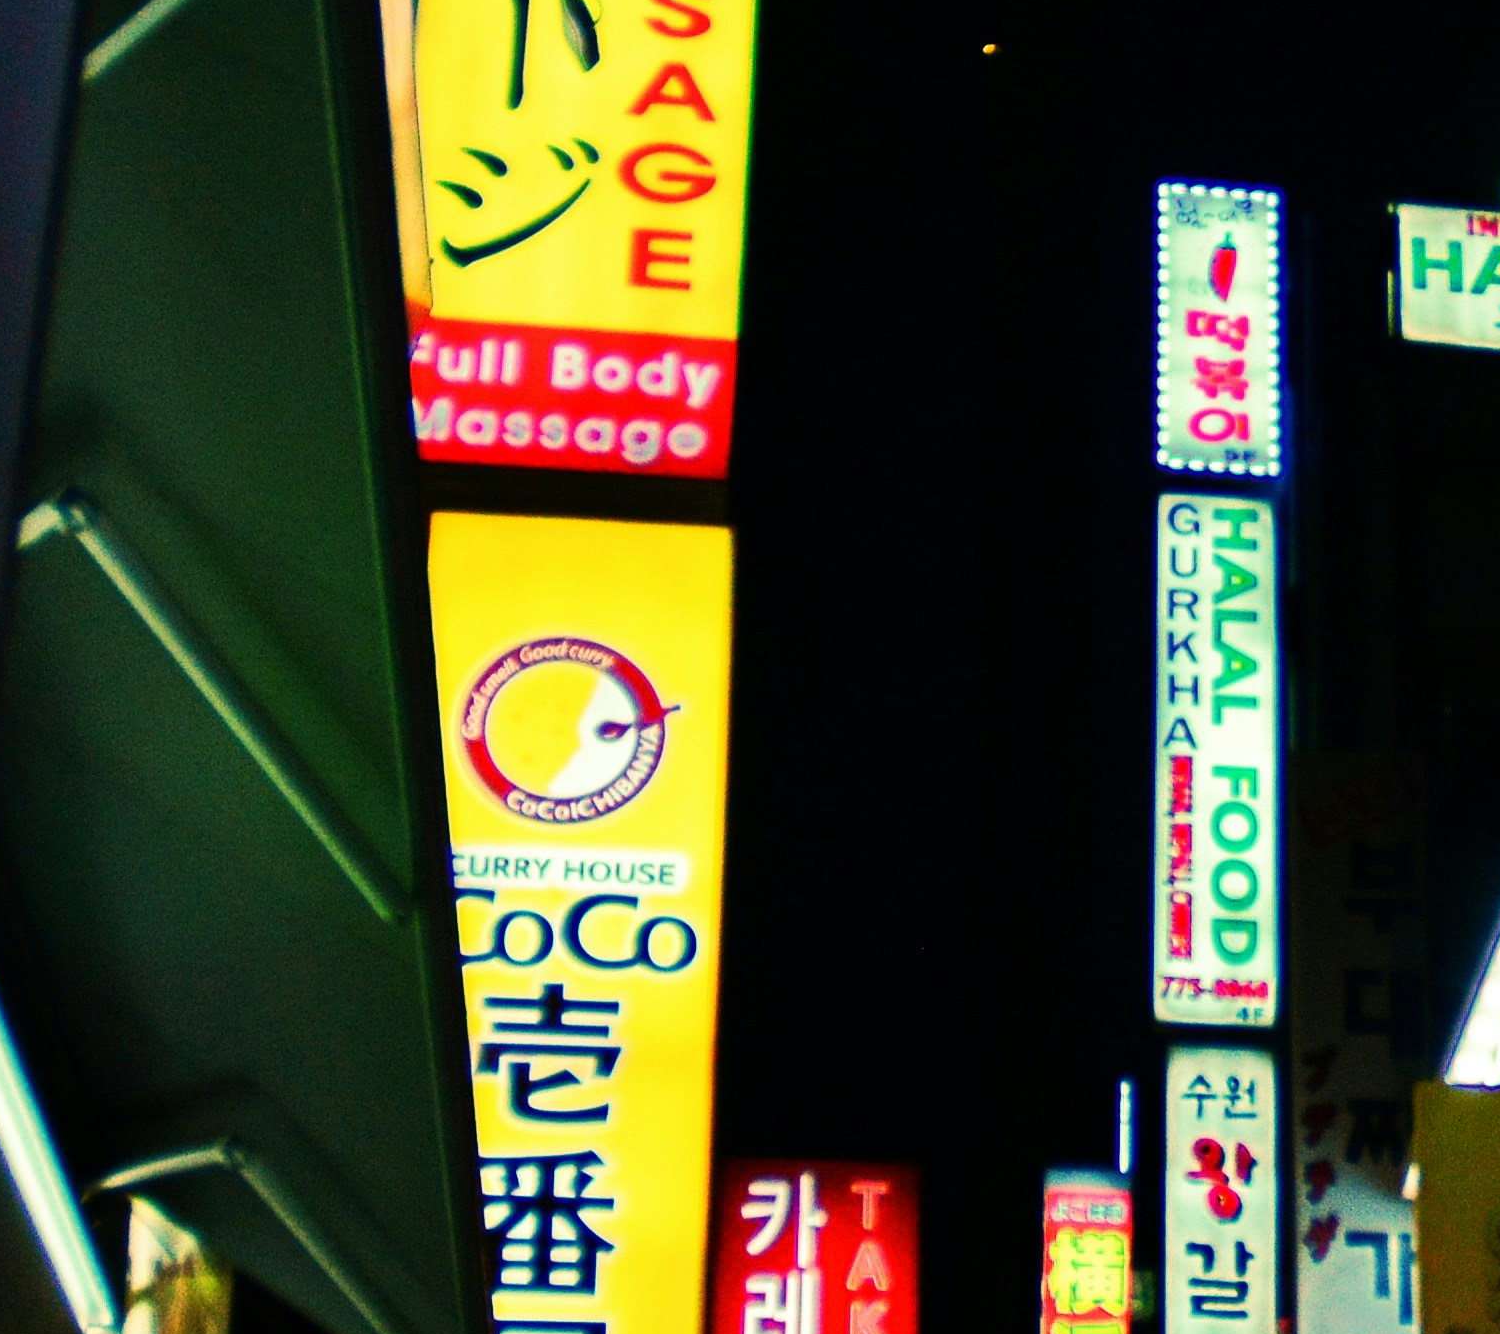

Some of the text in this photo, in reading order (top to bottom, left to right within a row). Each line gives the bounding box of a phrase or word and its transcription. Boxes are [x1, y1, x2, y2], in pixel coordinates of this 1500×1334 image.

[551, 341, 721, 410] Body
[1163, 500, 1198, 751] GURKHA
[1210, 507, 1259, 967] HALAL FOOD
[452, 853, 676, 887] CURRY HOUSE
[455, 887, 699, 972] CoCo
[1180, 1073, 1258, 1121] 수원
